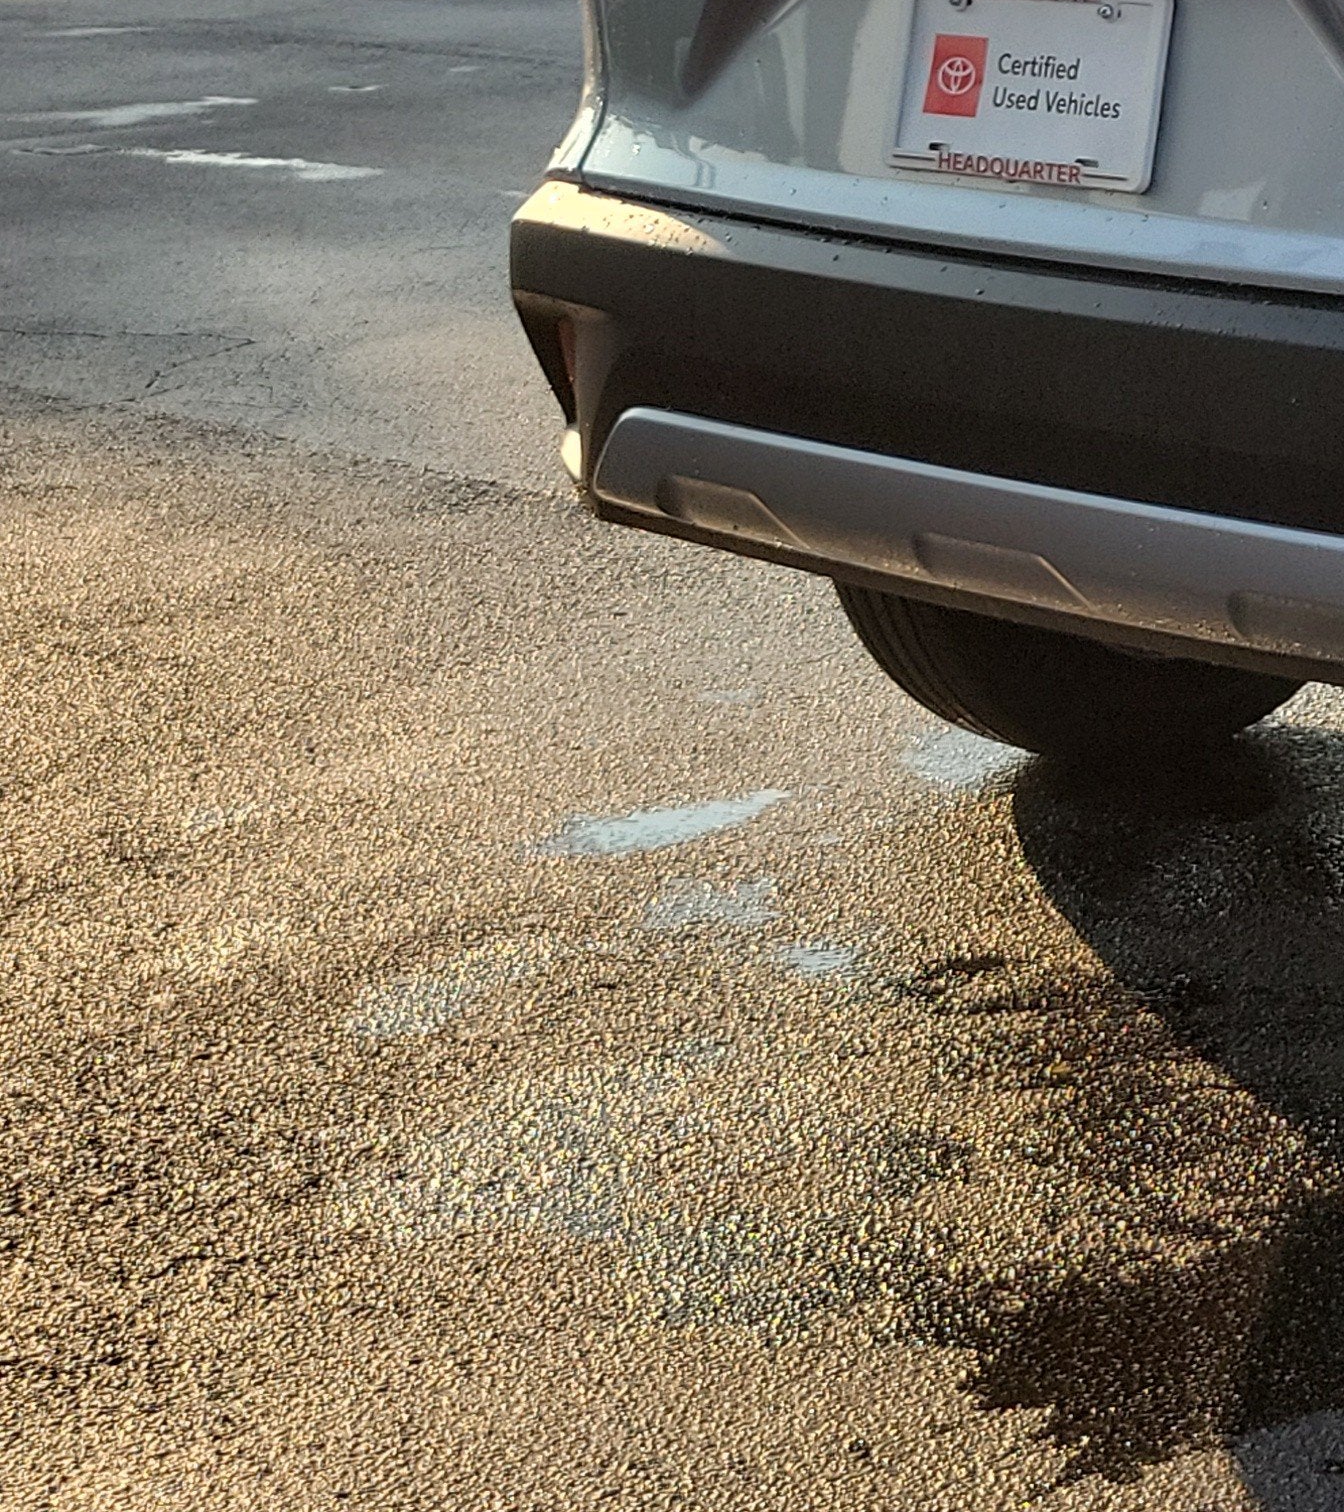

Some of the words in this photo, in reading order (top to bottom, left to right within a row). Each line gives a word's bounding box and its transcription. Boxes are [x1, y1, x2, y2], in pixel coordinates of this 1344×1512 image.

[998, 53, 1080, 80] Certified
[993, 86, 1040, 111] Used
[1046, 92, 1121, 119] Vehicles
[937, 152, 1081, 183] HEADQUARTER
